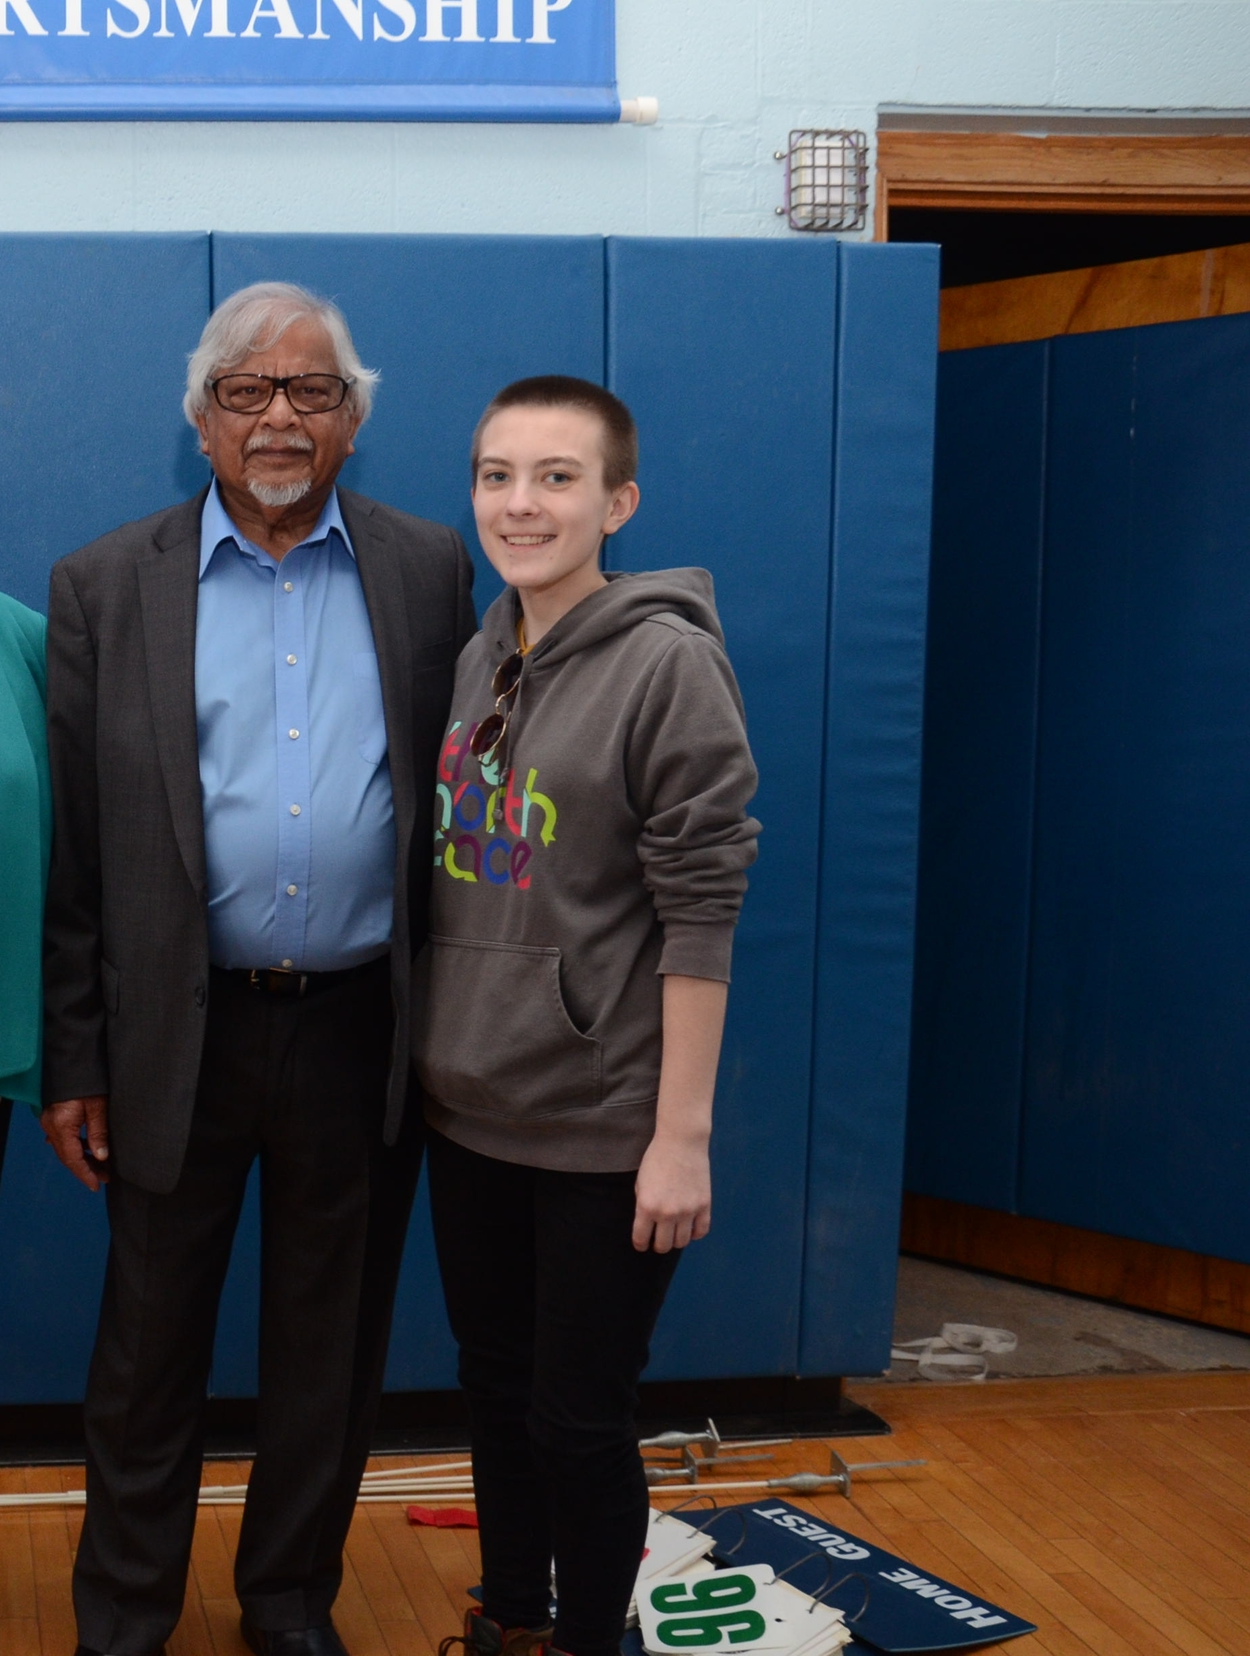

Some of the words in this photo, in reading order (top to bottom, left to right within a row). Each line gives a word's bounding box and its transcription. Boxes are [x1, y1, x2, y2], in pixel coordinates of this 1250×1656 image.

[434, 834, 533, 890] ace
[751, 1506, 871, 1561] GUEST
[650, 1573, 767, 1648] 96
[877, 1566, 1008, 1629] HOME
